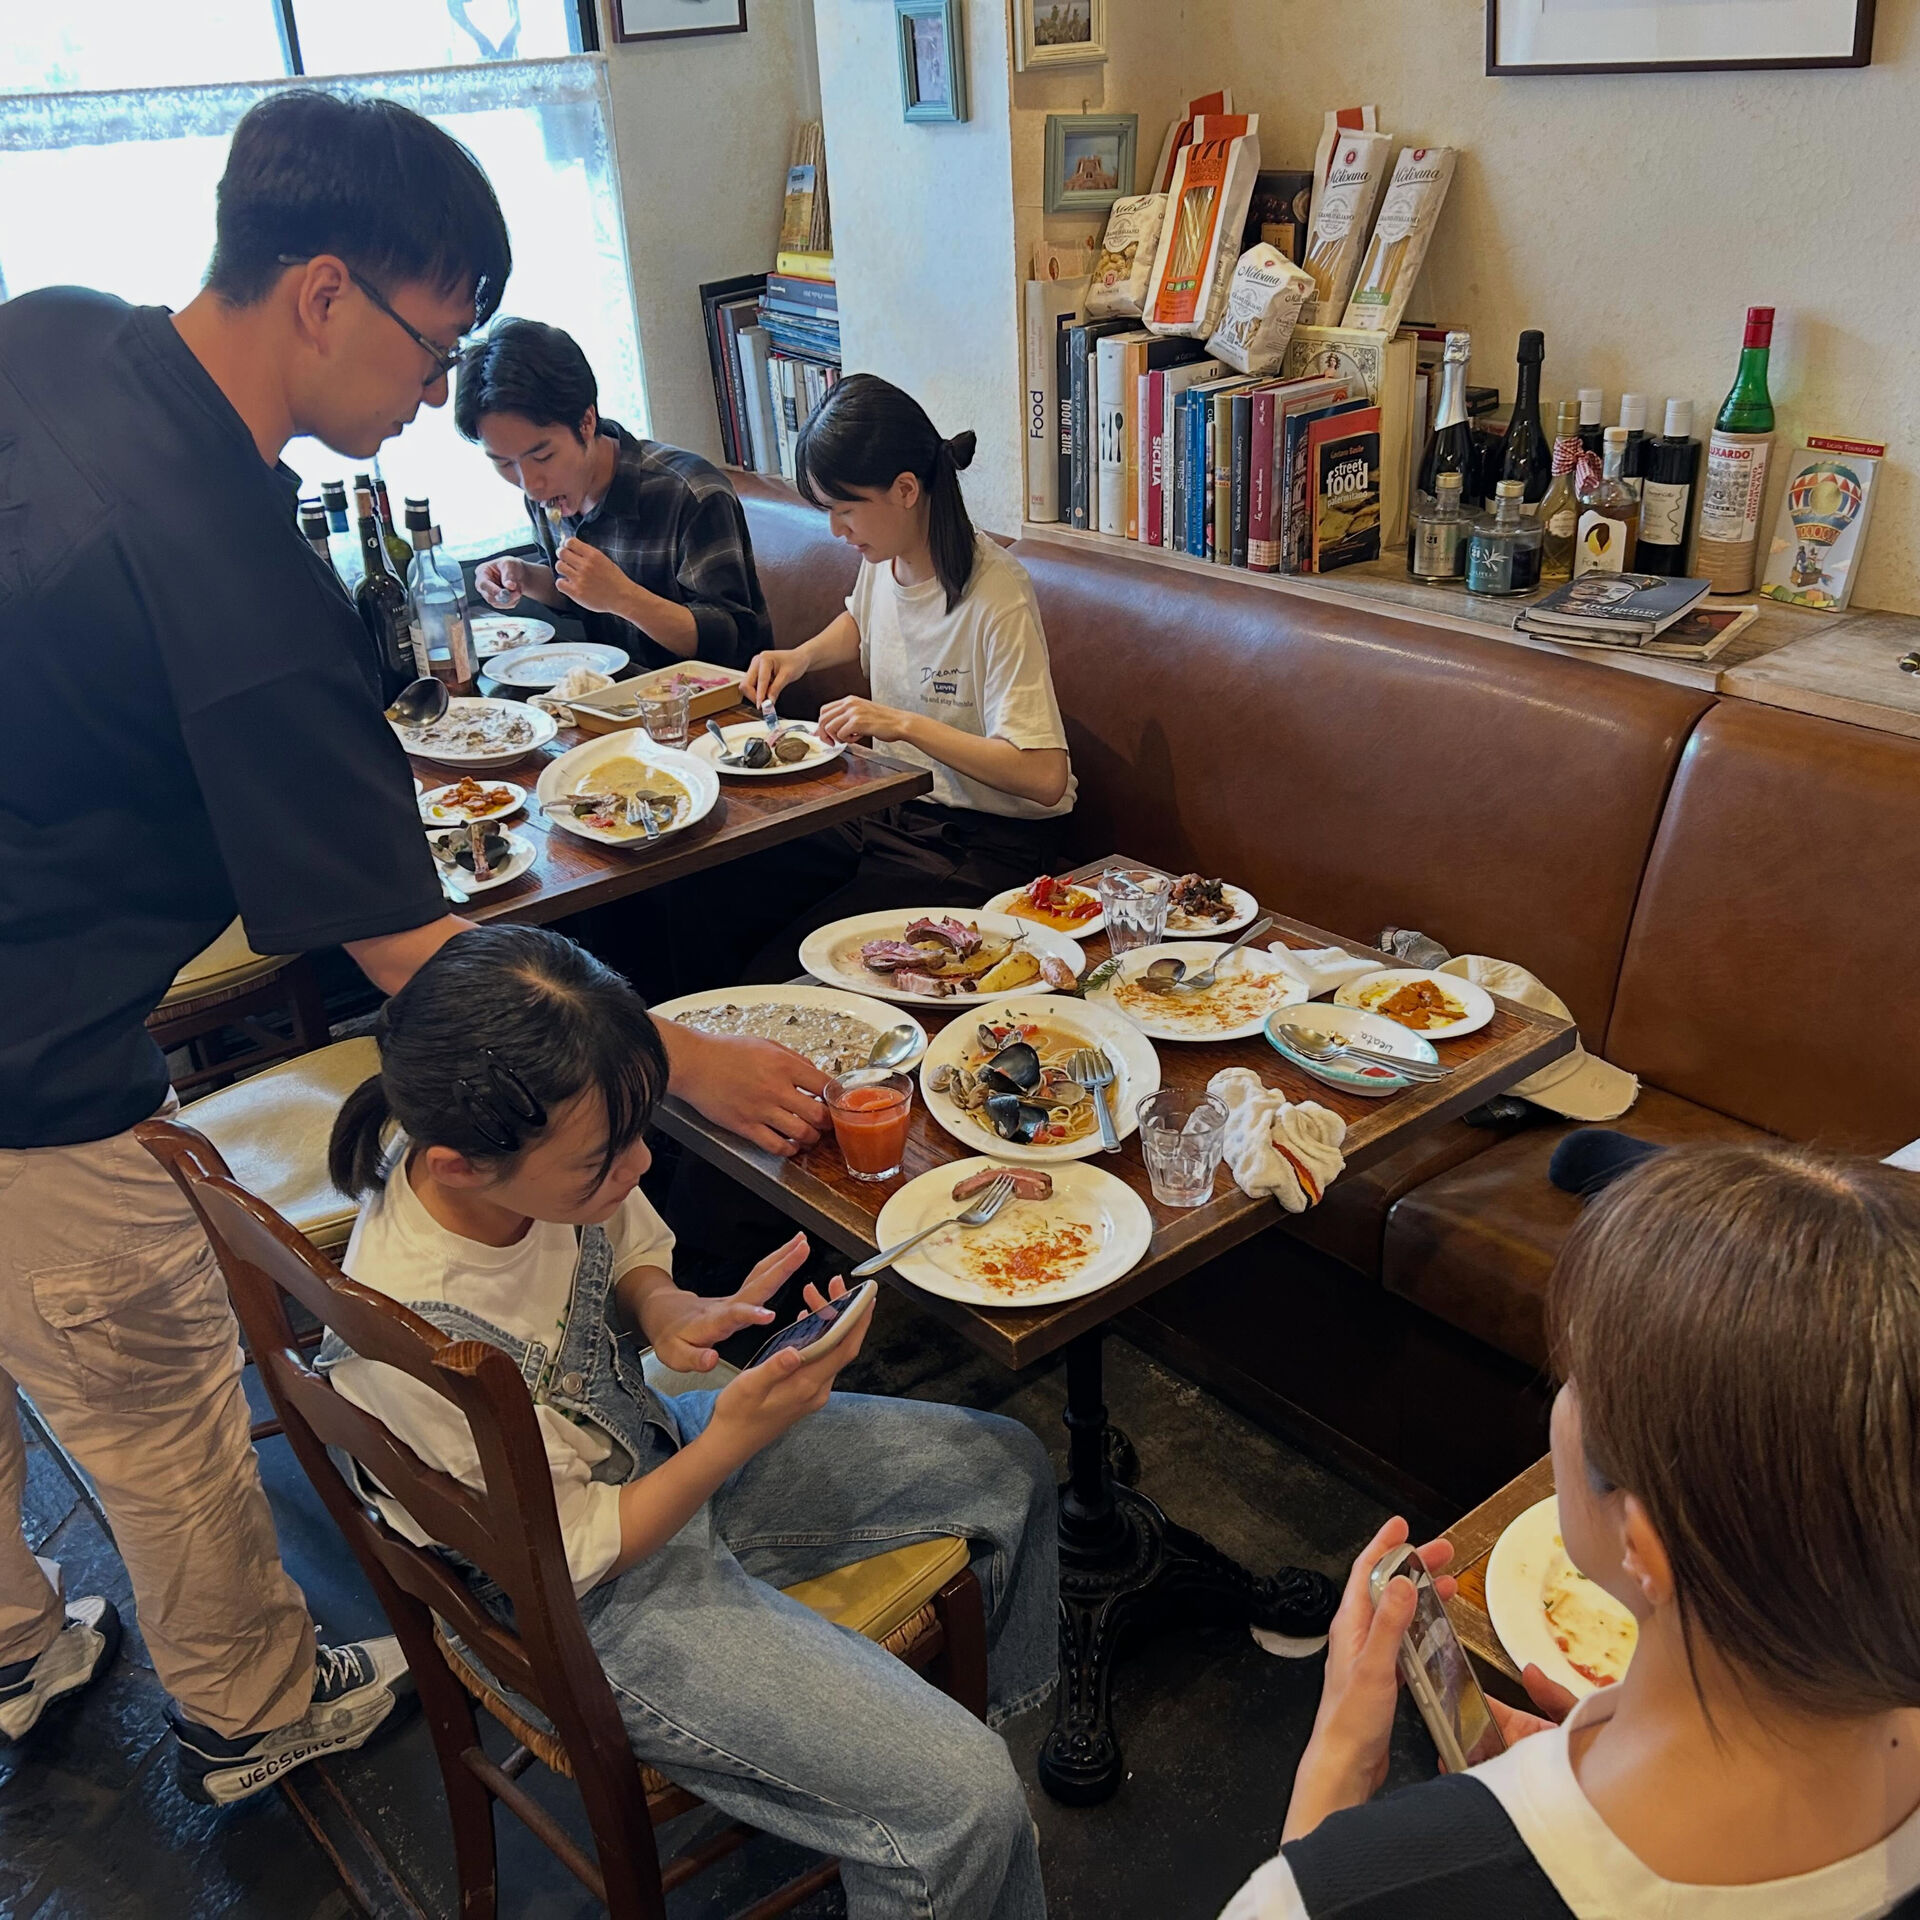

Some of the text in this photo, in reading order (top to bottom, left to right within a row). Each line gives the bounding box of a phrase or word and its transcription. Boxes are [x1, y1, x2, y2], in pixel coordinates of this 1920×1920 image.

[1030, 390, 1044, 439] Food
[1152, 435, 1161, 487] SICILIA
[1709, 446, 1751, 460] UXARDO
[1326, 462, 1369, 498] food
[1334, 458, 1363, 477] street
[920, 666, 971, 684] Dream
